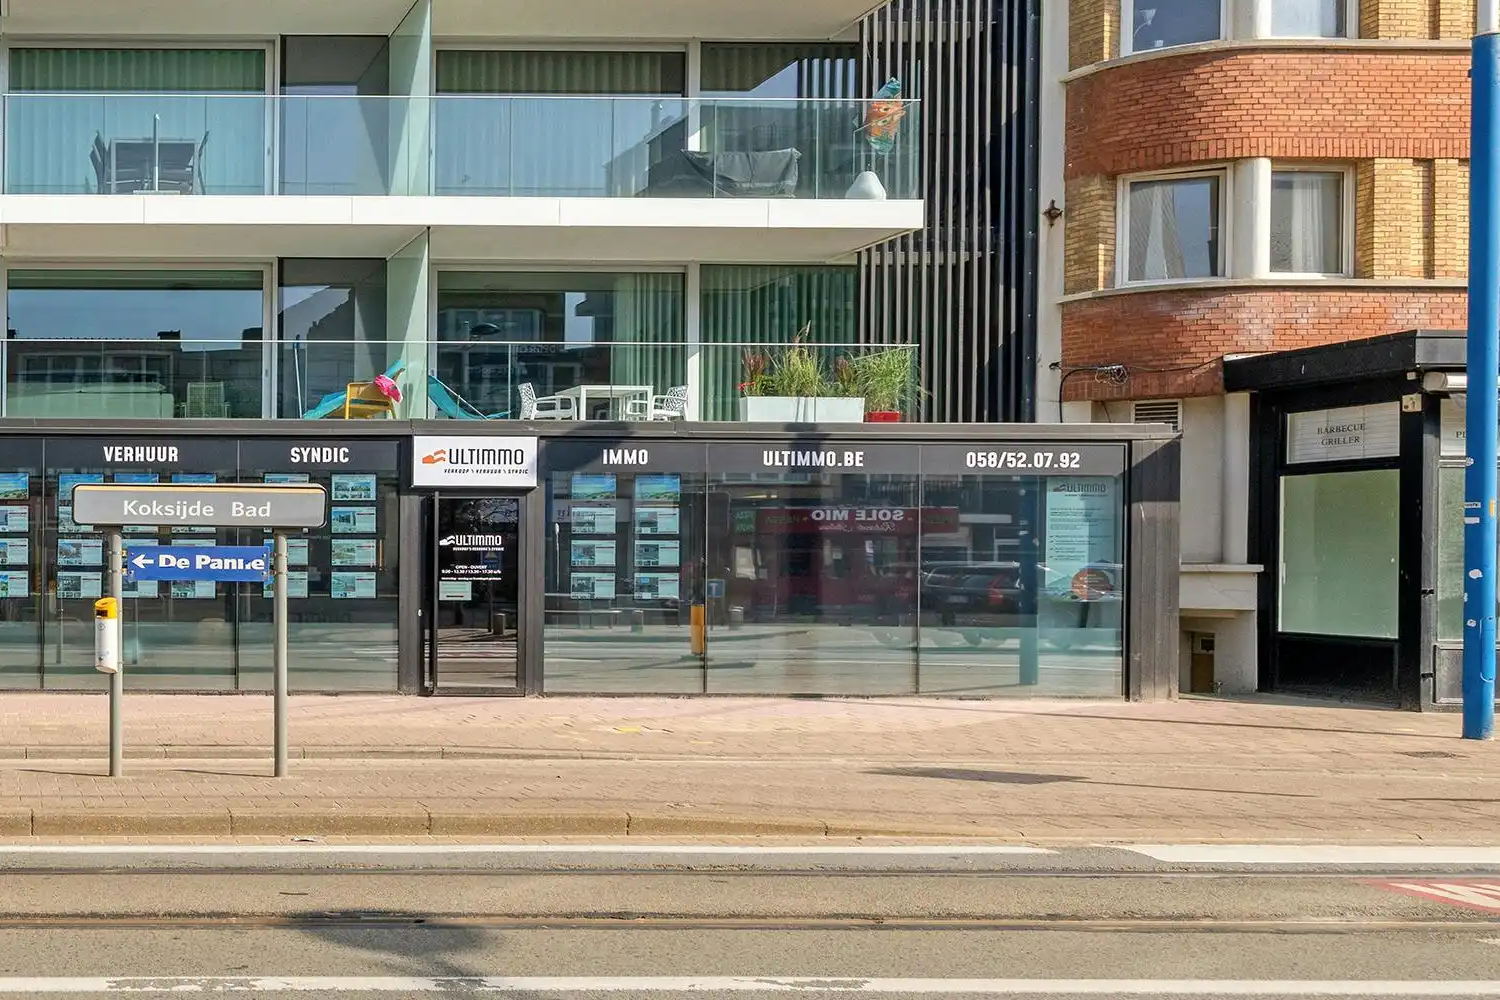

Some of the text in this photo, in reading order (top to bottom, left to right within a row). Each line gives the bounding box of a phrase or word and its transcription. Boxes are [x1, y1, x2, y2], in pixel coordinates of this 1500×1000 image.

[1317, 423, 1366, 435] BARBECUE
[1321, 435, 1361, 446] GRILLER
[103, 446, 179, 462] VERHUUR
[290, 447, 349, 463] SYNDIC
[449, 448, 524, 465] ULTIMMO
[602, 449, 649, 465] IMMO
[763, 450, 864, 467] ULTIMMO.BE
[966, 452, 1080, 468] 058/52.07.92
[123, 500, 271, 520] Koksijde Bad
[455, 534, 502, 546] ULTIMMO
[159, 554, 190, 569] De
